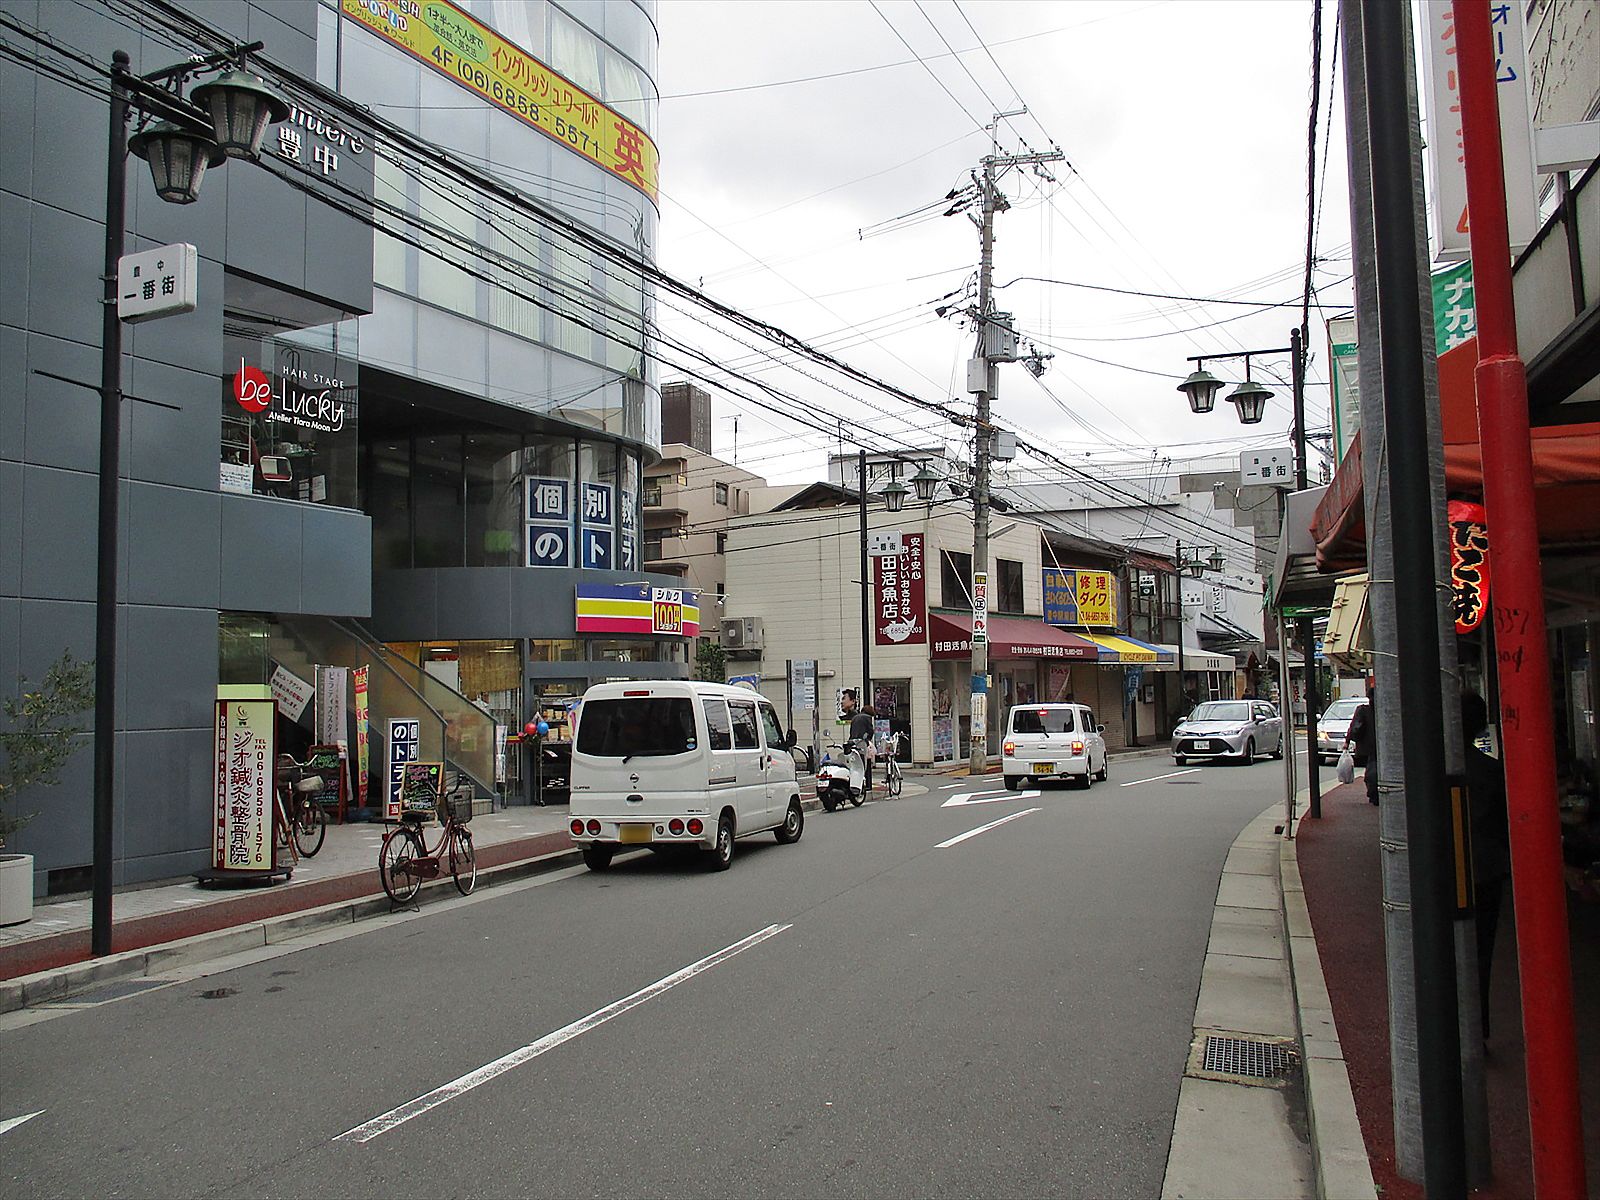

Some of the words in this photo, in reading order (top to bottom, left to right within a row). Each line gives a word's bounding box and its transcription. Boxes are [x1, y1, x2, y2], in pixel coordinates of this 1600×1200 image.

[432, 45, 453, 67] 4F
[277, 127, 338, 175] 豊中
[614, 120, 646, 186] 英
[124, 276, 174, 300] 一番街
[283, 366, 308, 380] HAIR
[313, 373, 345, 389] STAGE
[267, 411, 292, 424] Atelier
[293, 416, 311, 428] Tiara
[311, 421, 331, 433] Moon
[1247, 466, 1286, 477] 一番街
[910, 537, 921, 580] 安全・安心
[1080, 575, 1106, 590] 修理
[1080, 592, 1107, 606] ダイワ
[230, 731, 253, 866] ジオ鍼灸整骨院
[391, 805, 399, 813] 当
